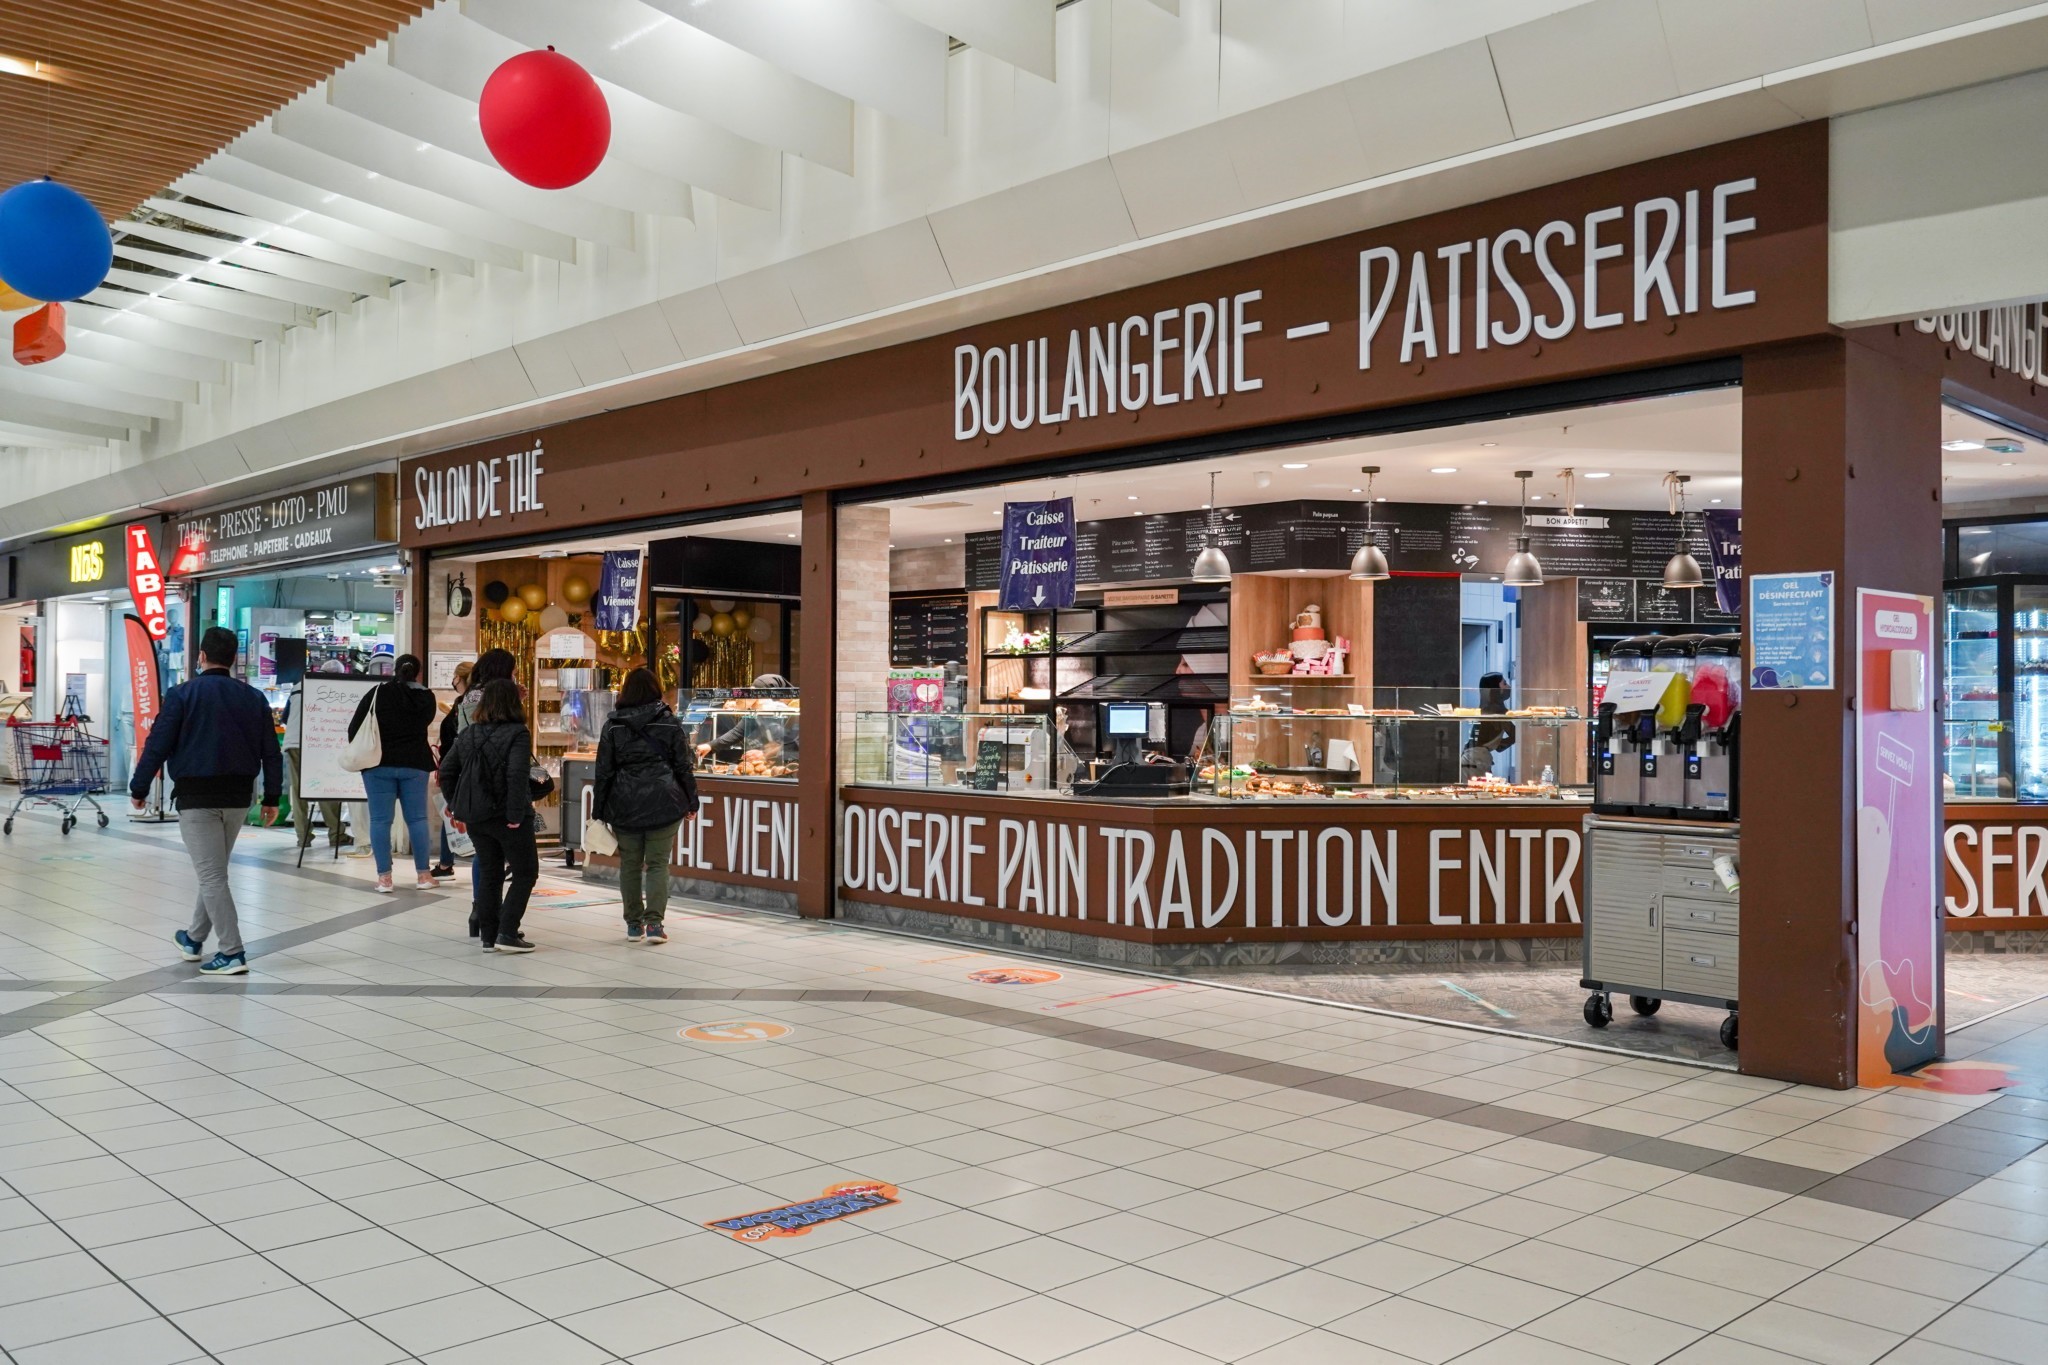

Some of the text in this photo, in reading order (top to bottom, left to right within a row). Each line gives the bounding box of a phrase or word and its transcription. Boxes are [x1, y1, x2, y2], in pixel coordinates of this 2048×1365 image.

[954, 289, 1263, 441] BOULANGERIE
[1359, 177, 1757, 369] PATISSERIE
[415, 438, 544, 530] SALON DE THÉ
[178, 517, 211, 547] TABAC
[220, 506, 262, 540] PRESSE
[272, 496, 306, 528] LOTO
[317, 485, 348, 519] PMU
[1026, 511, 1064, 526] Caisse
[210, 544, 248, 564] TELEPHONIE
[254, 536, 289, 556] PAPETERIE
[294, 528, 332, 549] CADEAUX
[1020, 535, 1068, 550] Traiteur
[617, 556, 639, 569] Caisse
[1011, 558, 1068, 574] Pâtisserie
[132, 530, 166, 636] TABAC
[1760, 590, 1824, 600] DÉSINFECTANT
[1782, 582, 1799, 590] GEL
[668, 795, 714, 870] HE
[844, 804, 986, 906] OISERIE
[998, 818, 1088, 920] PAIN
[1100, 826, 1398, 929] TRADITION
[1429, 828, 1582, 925] ENTR
